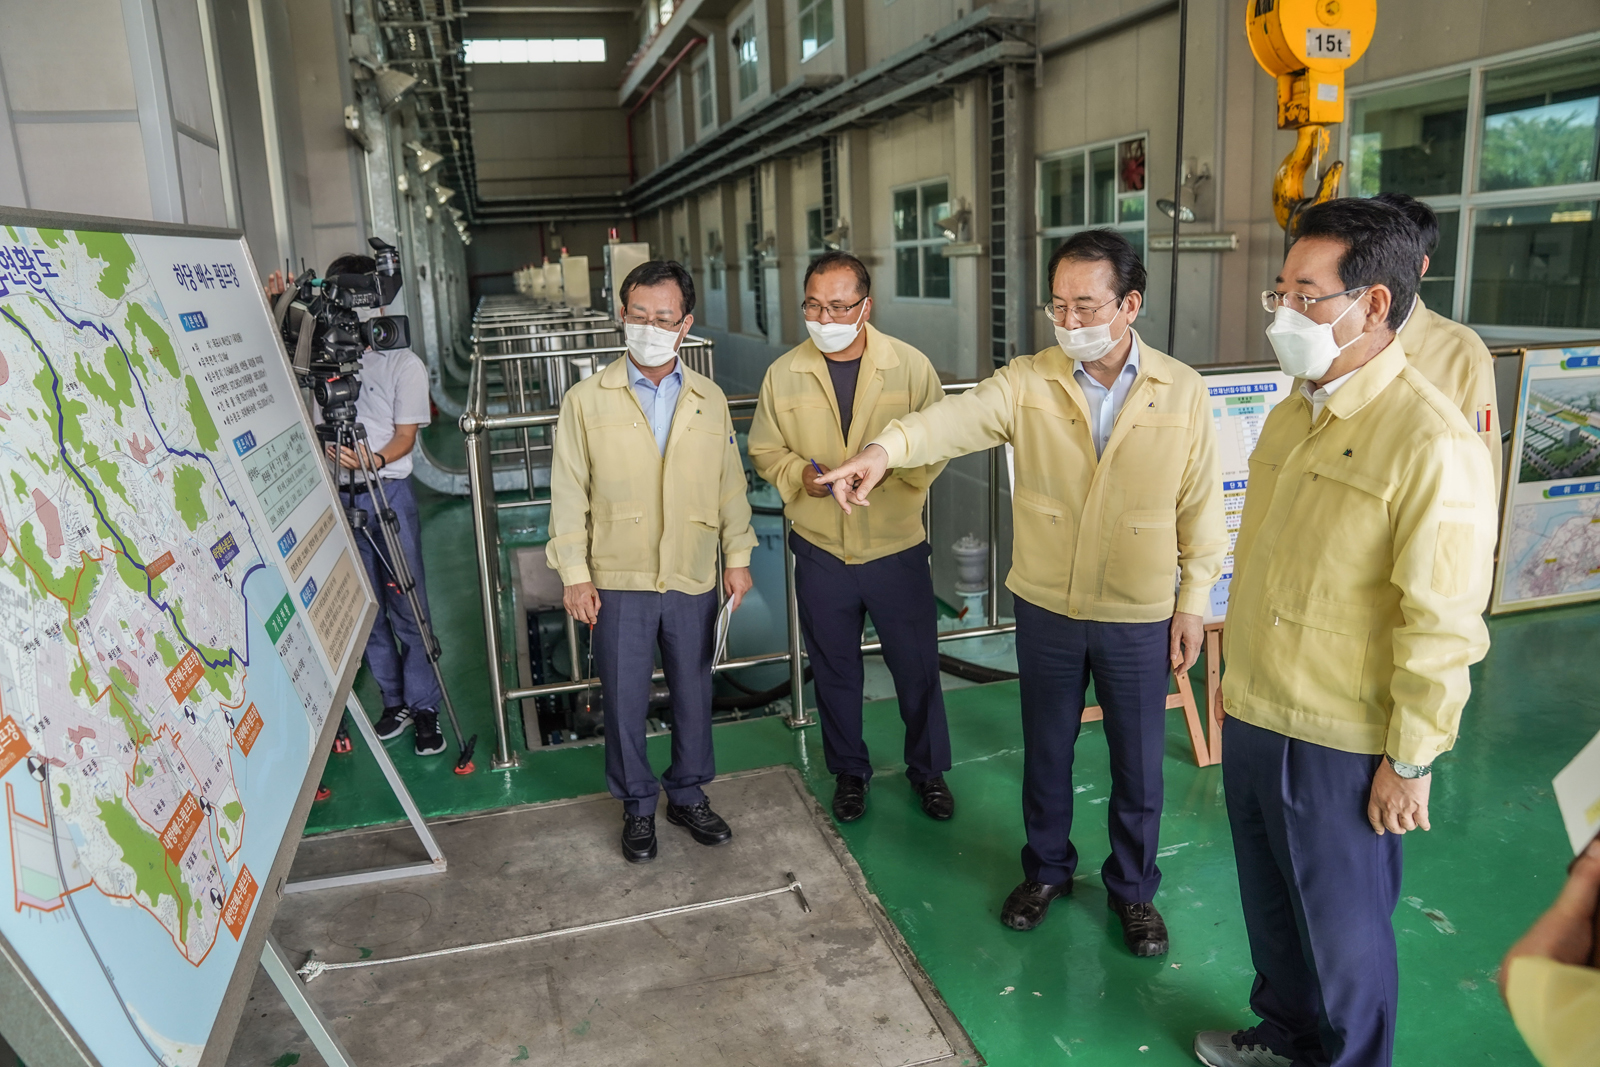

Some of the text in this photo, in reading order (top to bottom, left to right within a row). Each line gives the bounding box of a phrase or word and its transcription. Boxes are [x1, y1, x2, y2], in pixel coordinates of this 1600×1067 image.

[1315, 34, 1342, 52] 15t
[173, 263, 240, 291] 하당 배수 펌프장
[168, 651, 200, 693] 용당배수펌프장
[163, 794, 197, 848] 내항배수펌프장
[224, 870, 252, 927] 해안로배수펌프장
